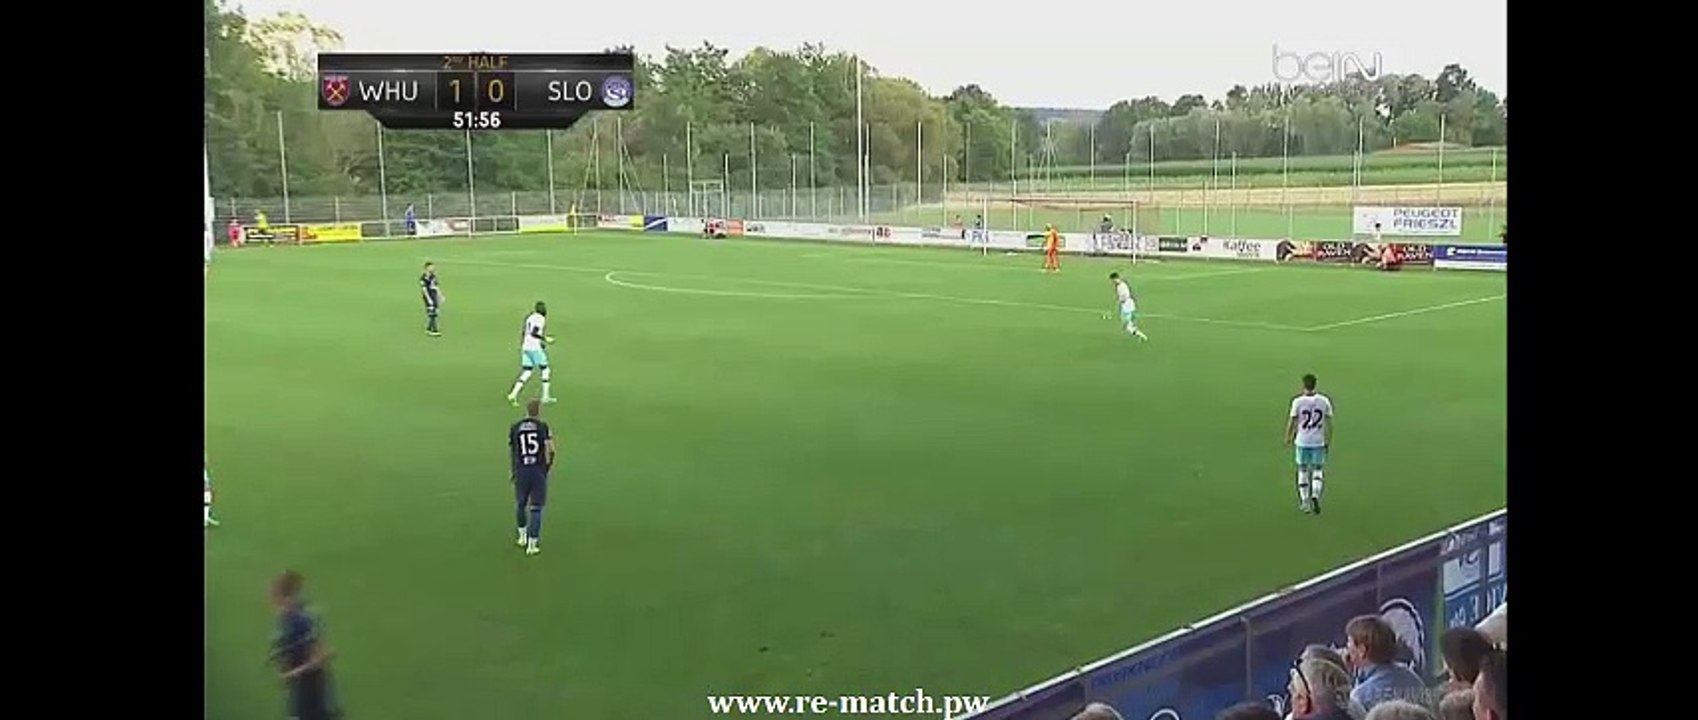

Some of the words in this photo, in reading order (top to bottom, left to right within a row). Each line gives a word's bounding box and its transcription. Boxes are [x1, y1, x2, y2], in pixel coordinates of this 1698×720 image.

[1393, 208, 1459, 218] PEUGEOT
[1393, 218, 1458, 229] FRIESZL
[1222, 239, 1262, 252] Kaffee
[1302, 409, 1323, 430] 22
[520, 433, 540, 455] 15
